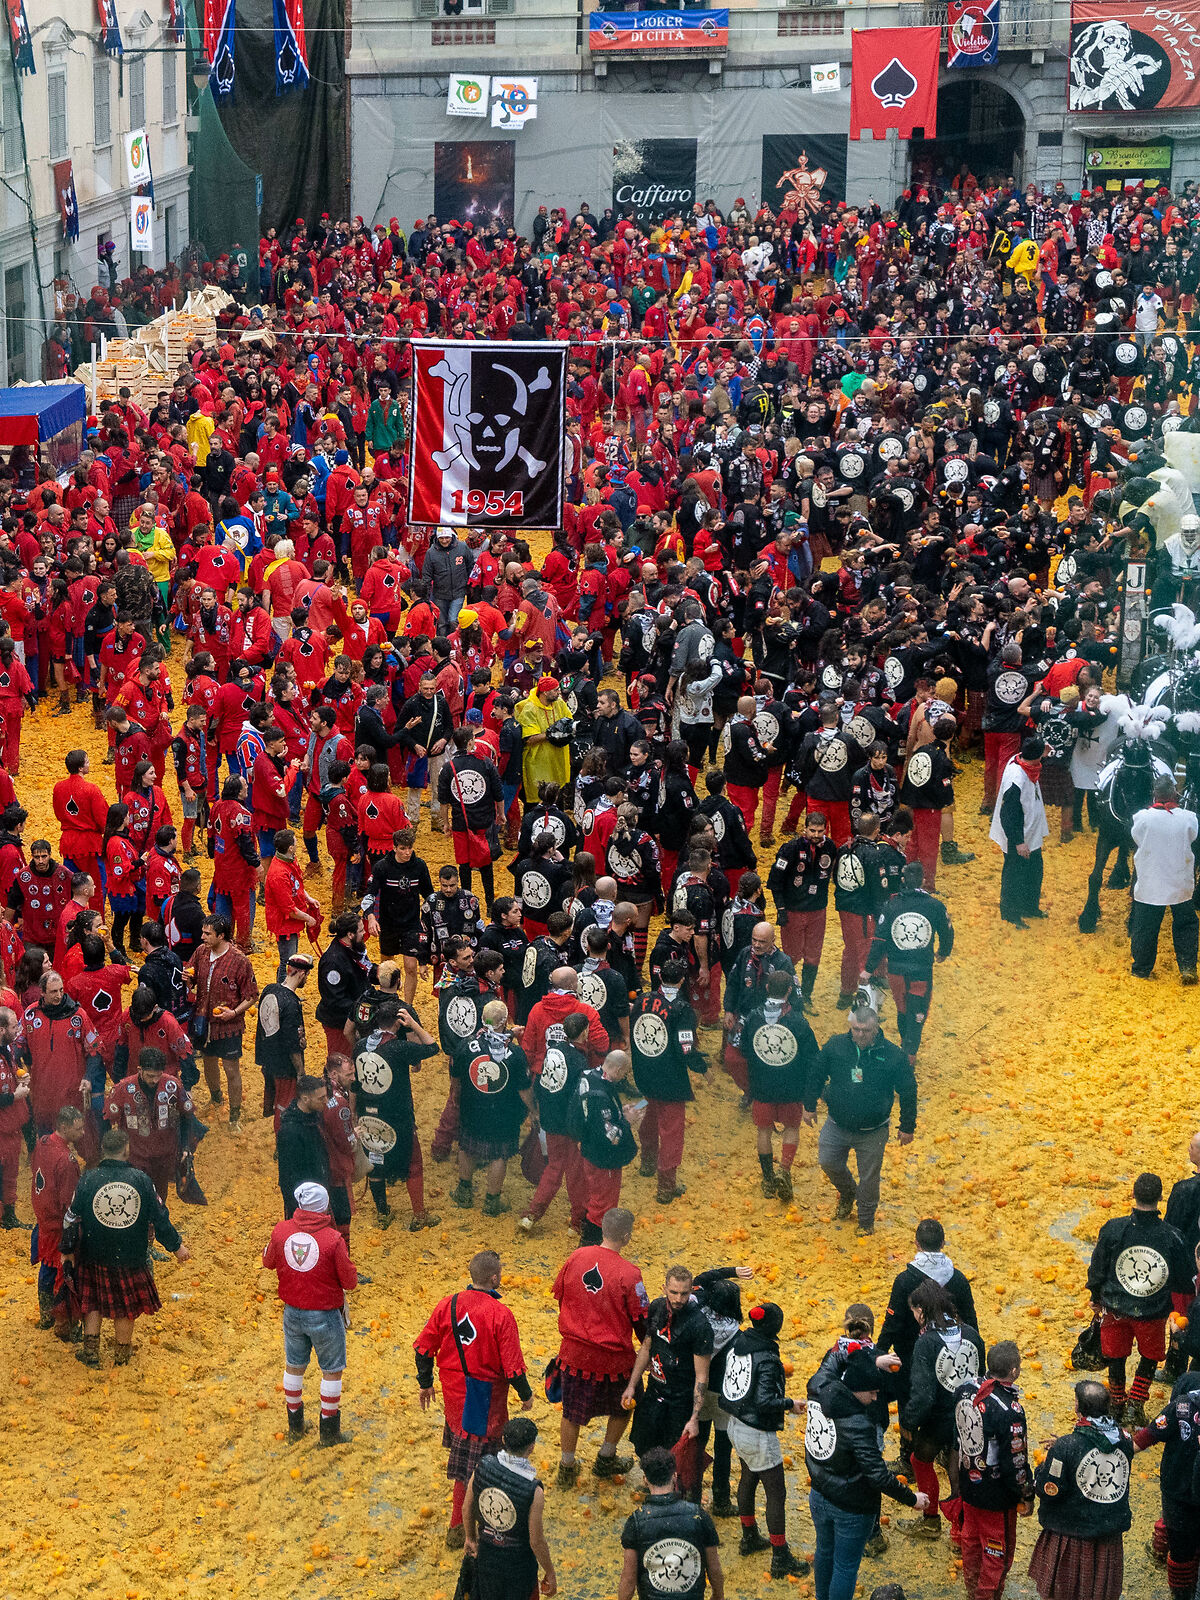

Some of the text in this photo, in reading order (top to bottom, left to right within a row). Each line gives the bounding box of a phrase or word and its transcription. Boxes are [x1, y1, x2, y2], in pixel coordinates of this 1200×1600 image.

[641, 16, 683, 27] JOKER
[631, 31, 643, 42] DI
[1151, 24, 1196, 81] PIAZZA
[616, 184, 692, 208] Caffaro
[451, 489, 525, 517] 1954
[1127, 566, 1145, 589] J
